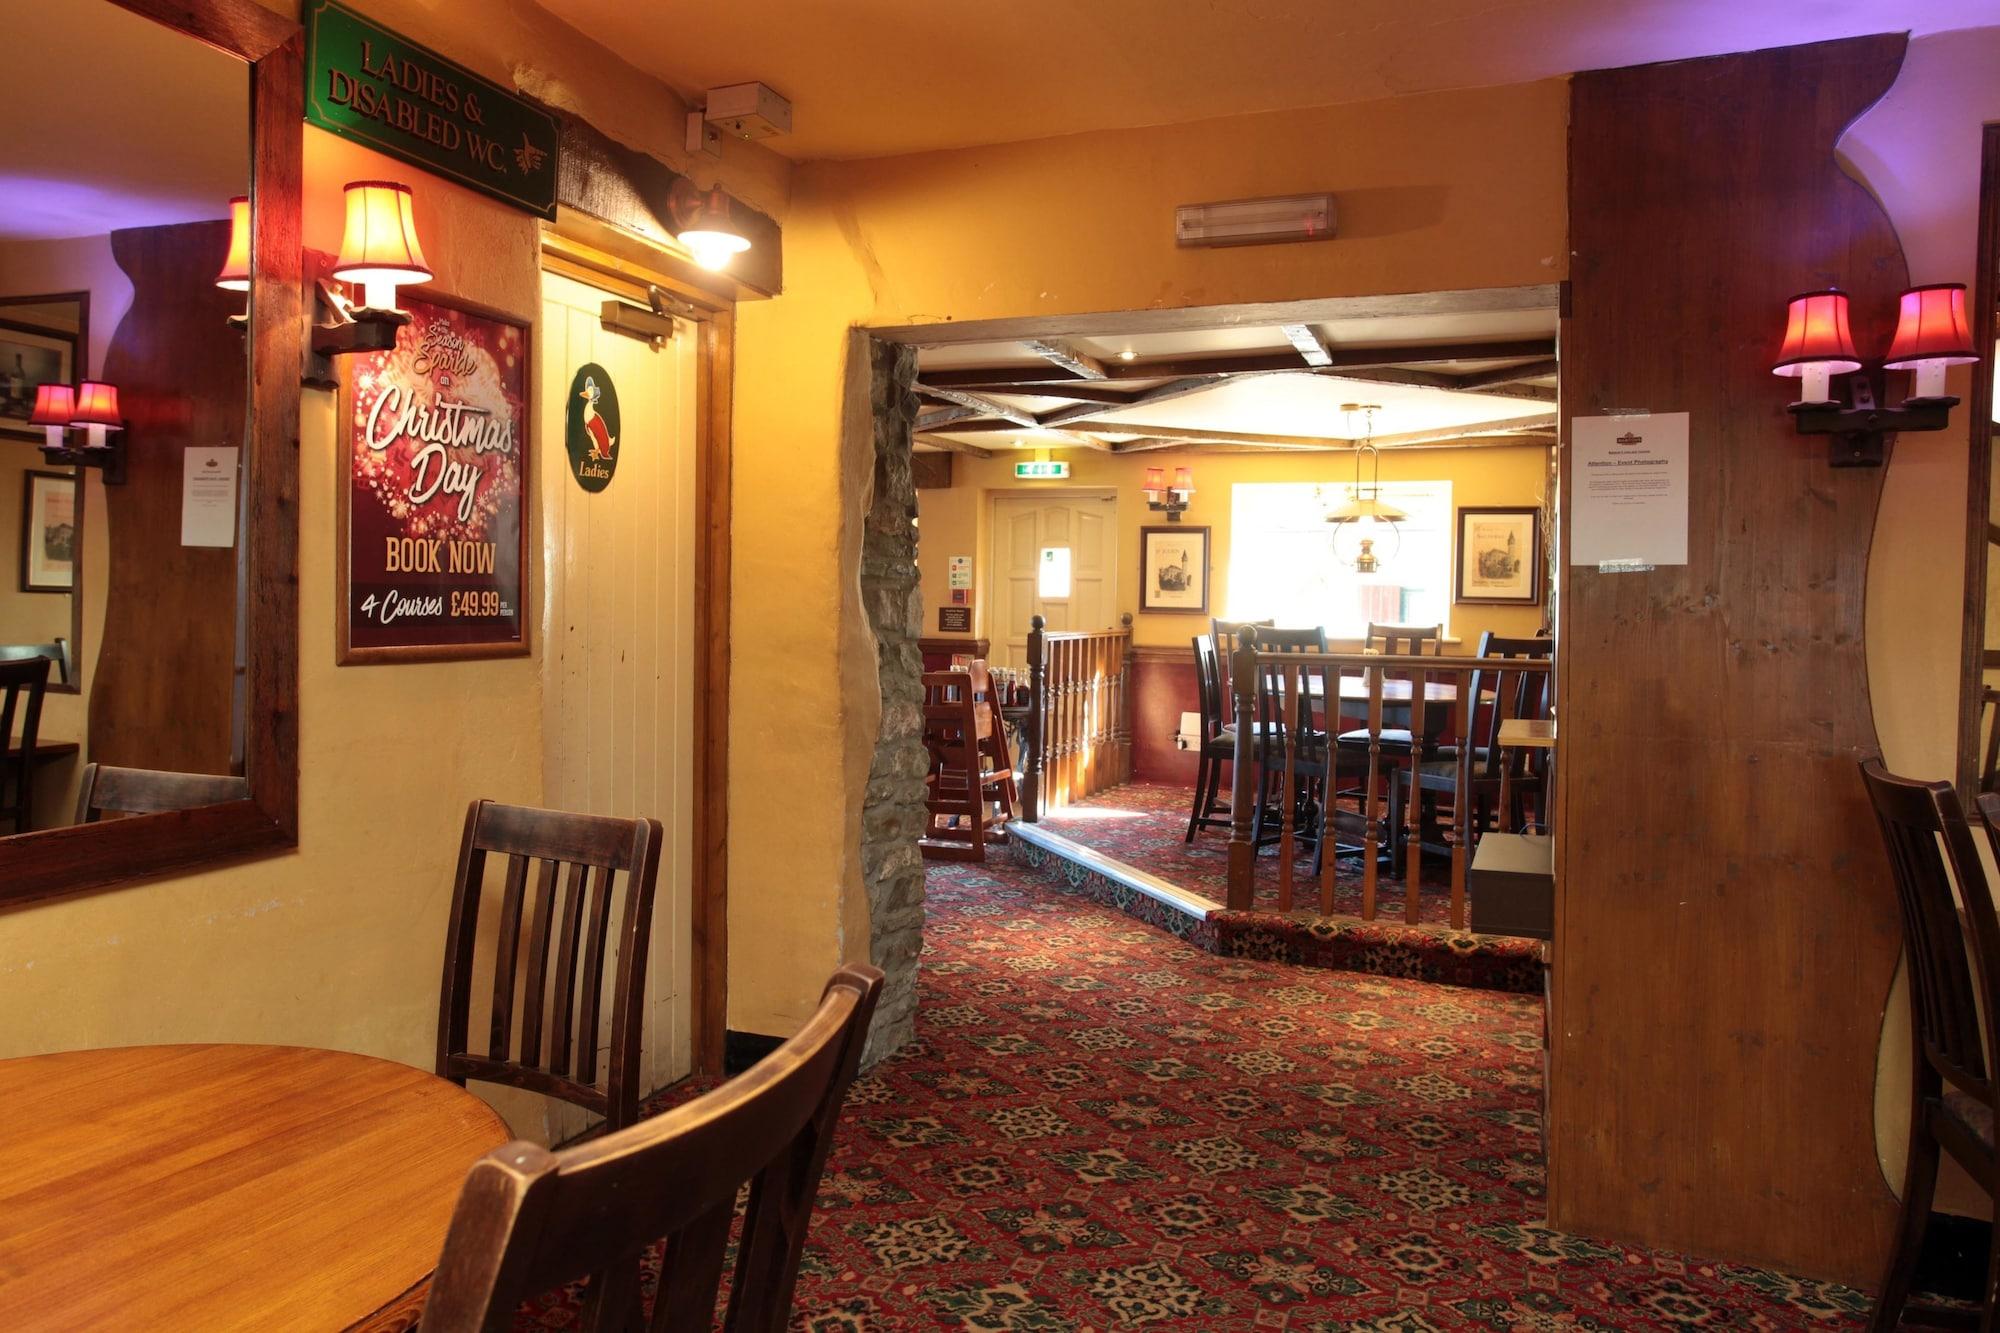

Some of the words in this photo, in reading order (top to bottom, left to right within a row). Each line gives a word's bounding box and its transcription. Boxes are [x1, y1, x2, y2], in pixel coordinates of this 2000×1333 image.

[360, 40, 459, 113] LADIES
[464, 92, 486, 126] &
[329, 68, 461, 150] DISABLED
[424, 324, 465, 352] Season
[412, 343, 478, 377] Sparkle
[440, 376, 450, 386] on
[366, 384, 513, 454] Christmas
[408, 442, 483, 522] Day
[579, 461, 609, 479] Ladies
[386, 537, 442, 573] BOOK
[448, 540, 497, 575] NOW
[360, 593, 381, 619] 4
[380, 589, 443, 625] Courses
[450, 590, 500, 617] £49.99
